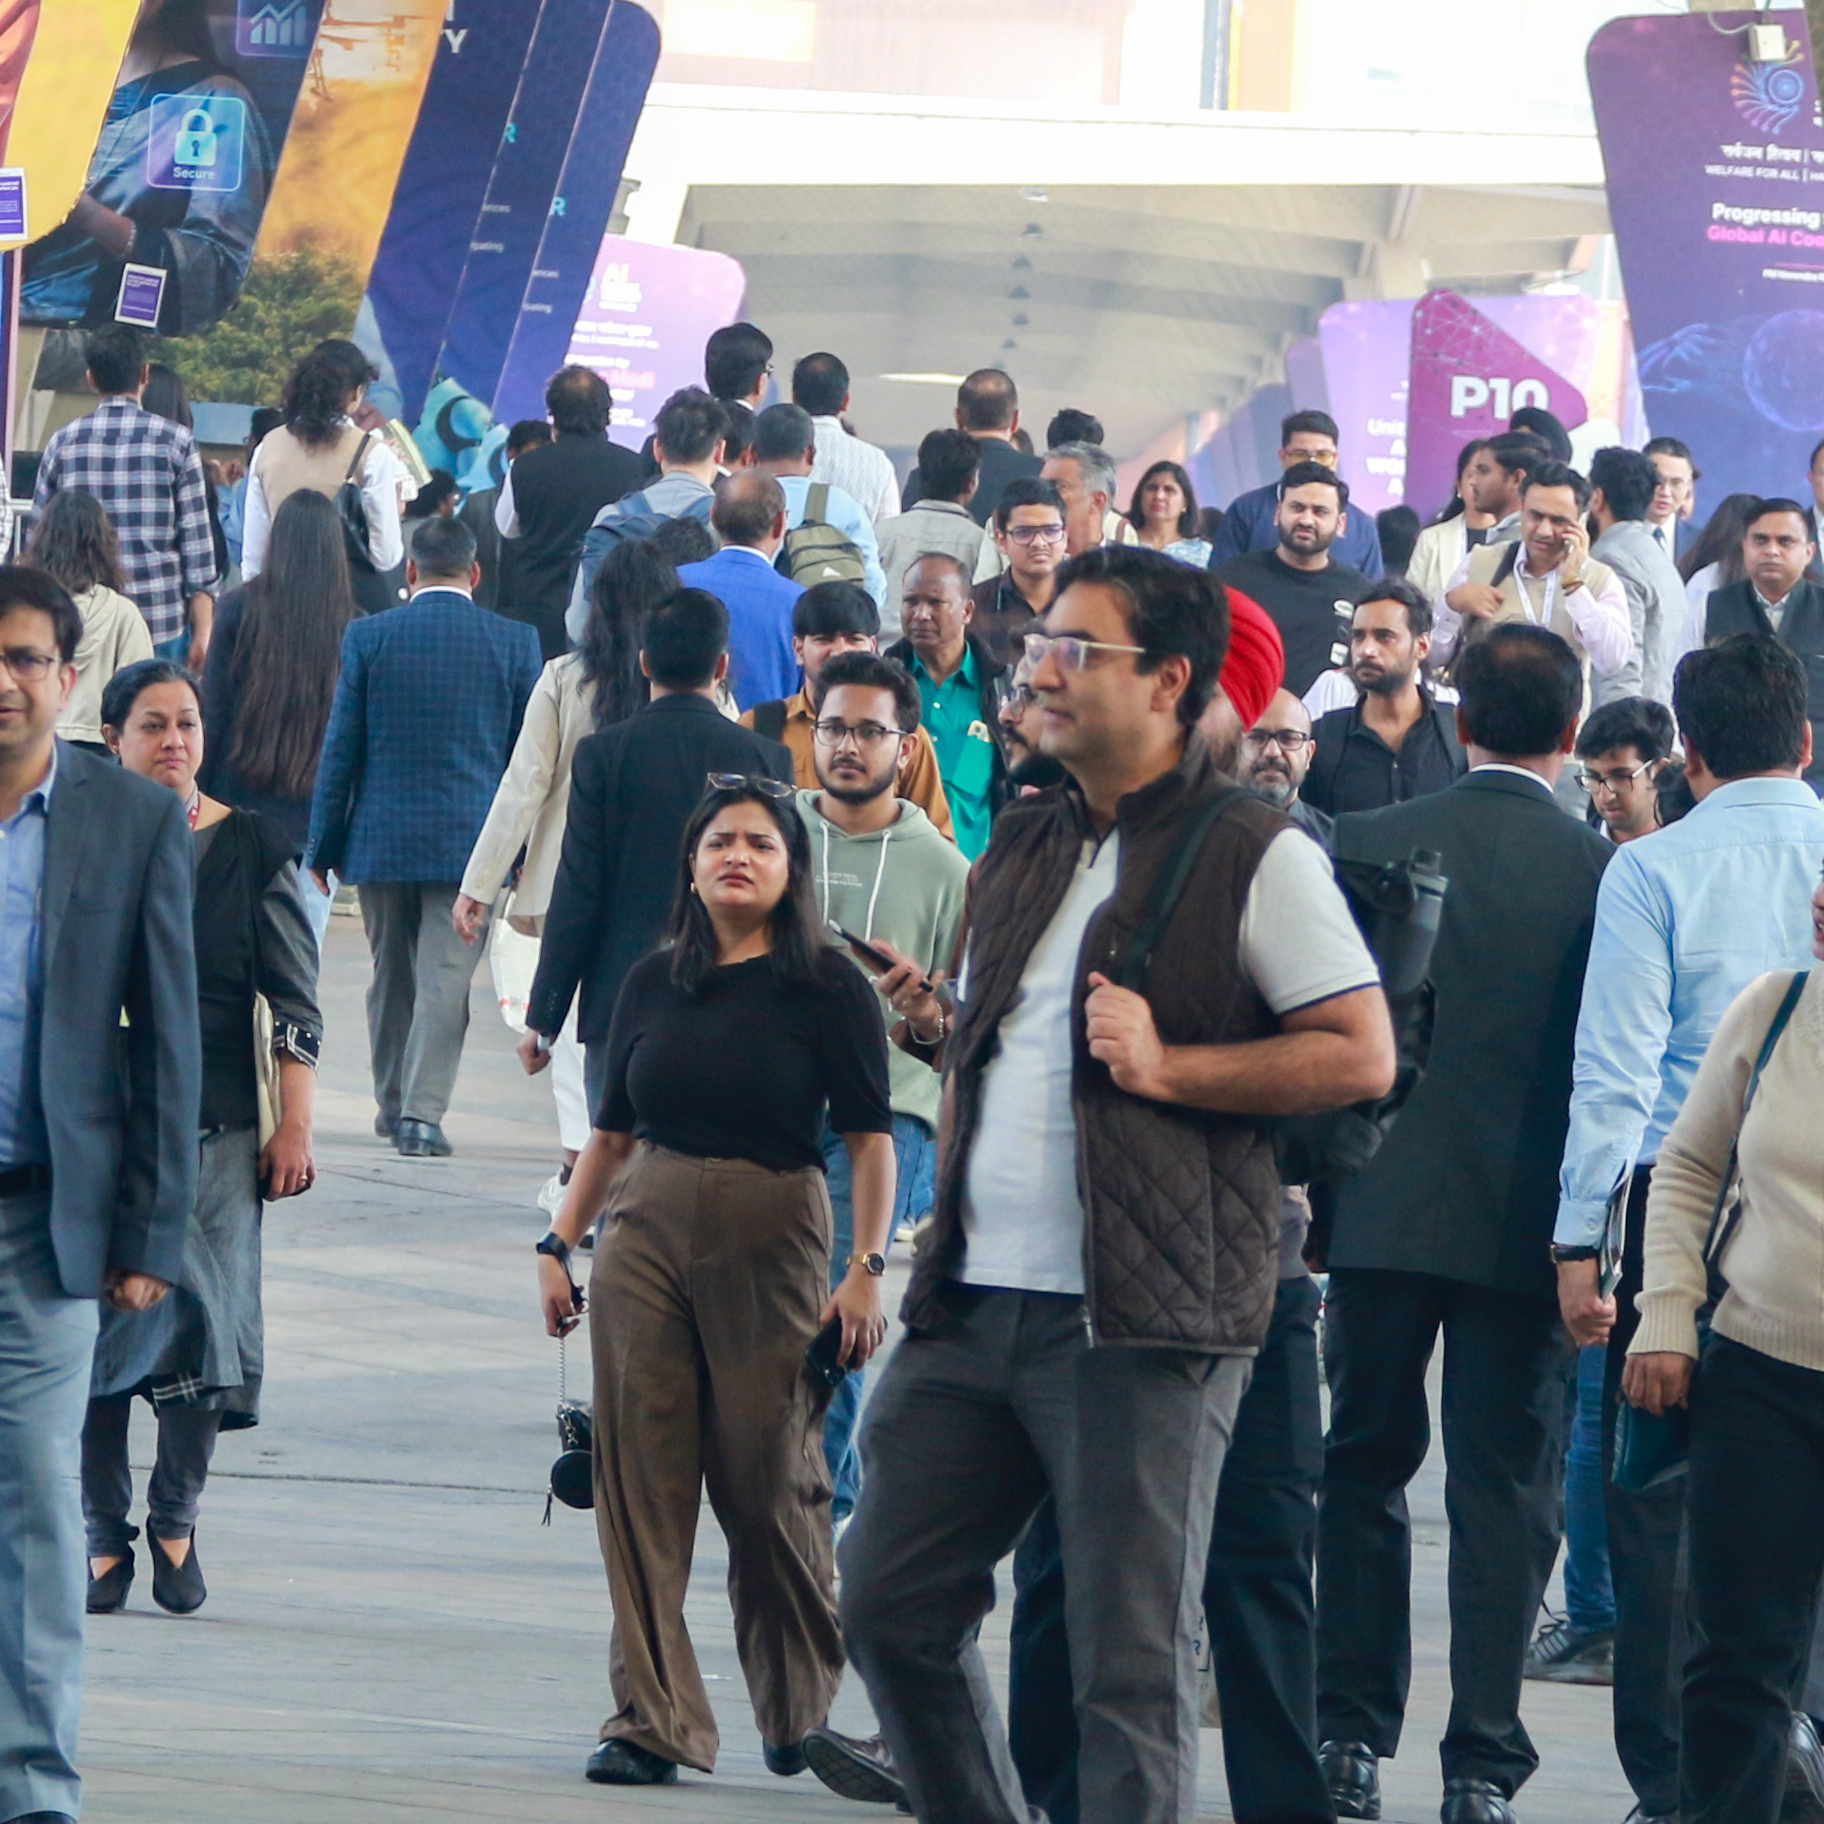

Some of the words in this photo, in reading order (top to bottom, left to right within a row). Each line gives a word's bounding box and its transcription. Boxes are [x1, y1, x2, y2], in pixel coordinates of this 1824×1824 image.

[172, 166, 215, 180] Secure
[1705, 164, 1755, 177] WELFARE
[1712, 202, 1821, 231] Progressing
[1707, 225, 1765, 243] Global
[1767, 228, 1787, 245] AI
[1449, 375, 1550, 421] P10
